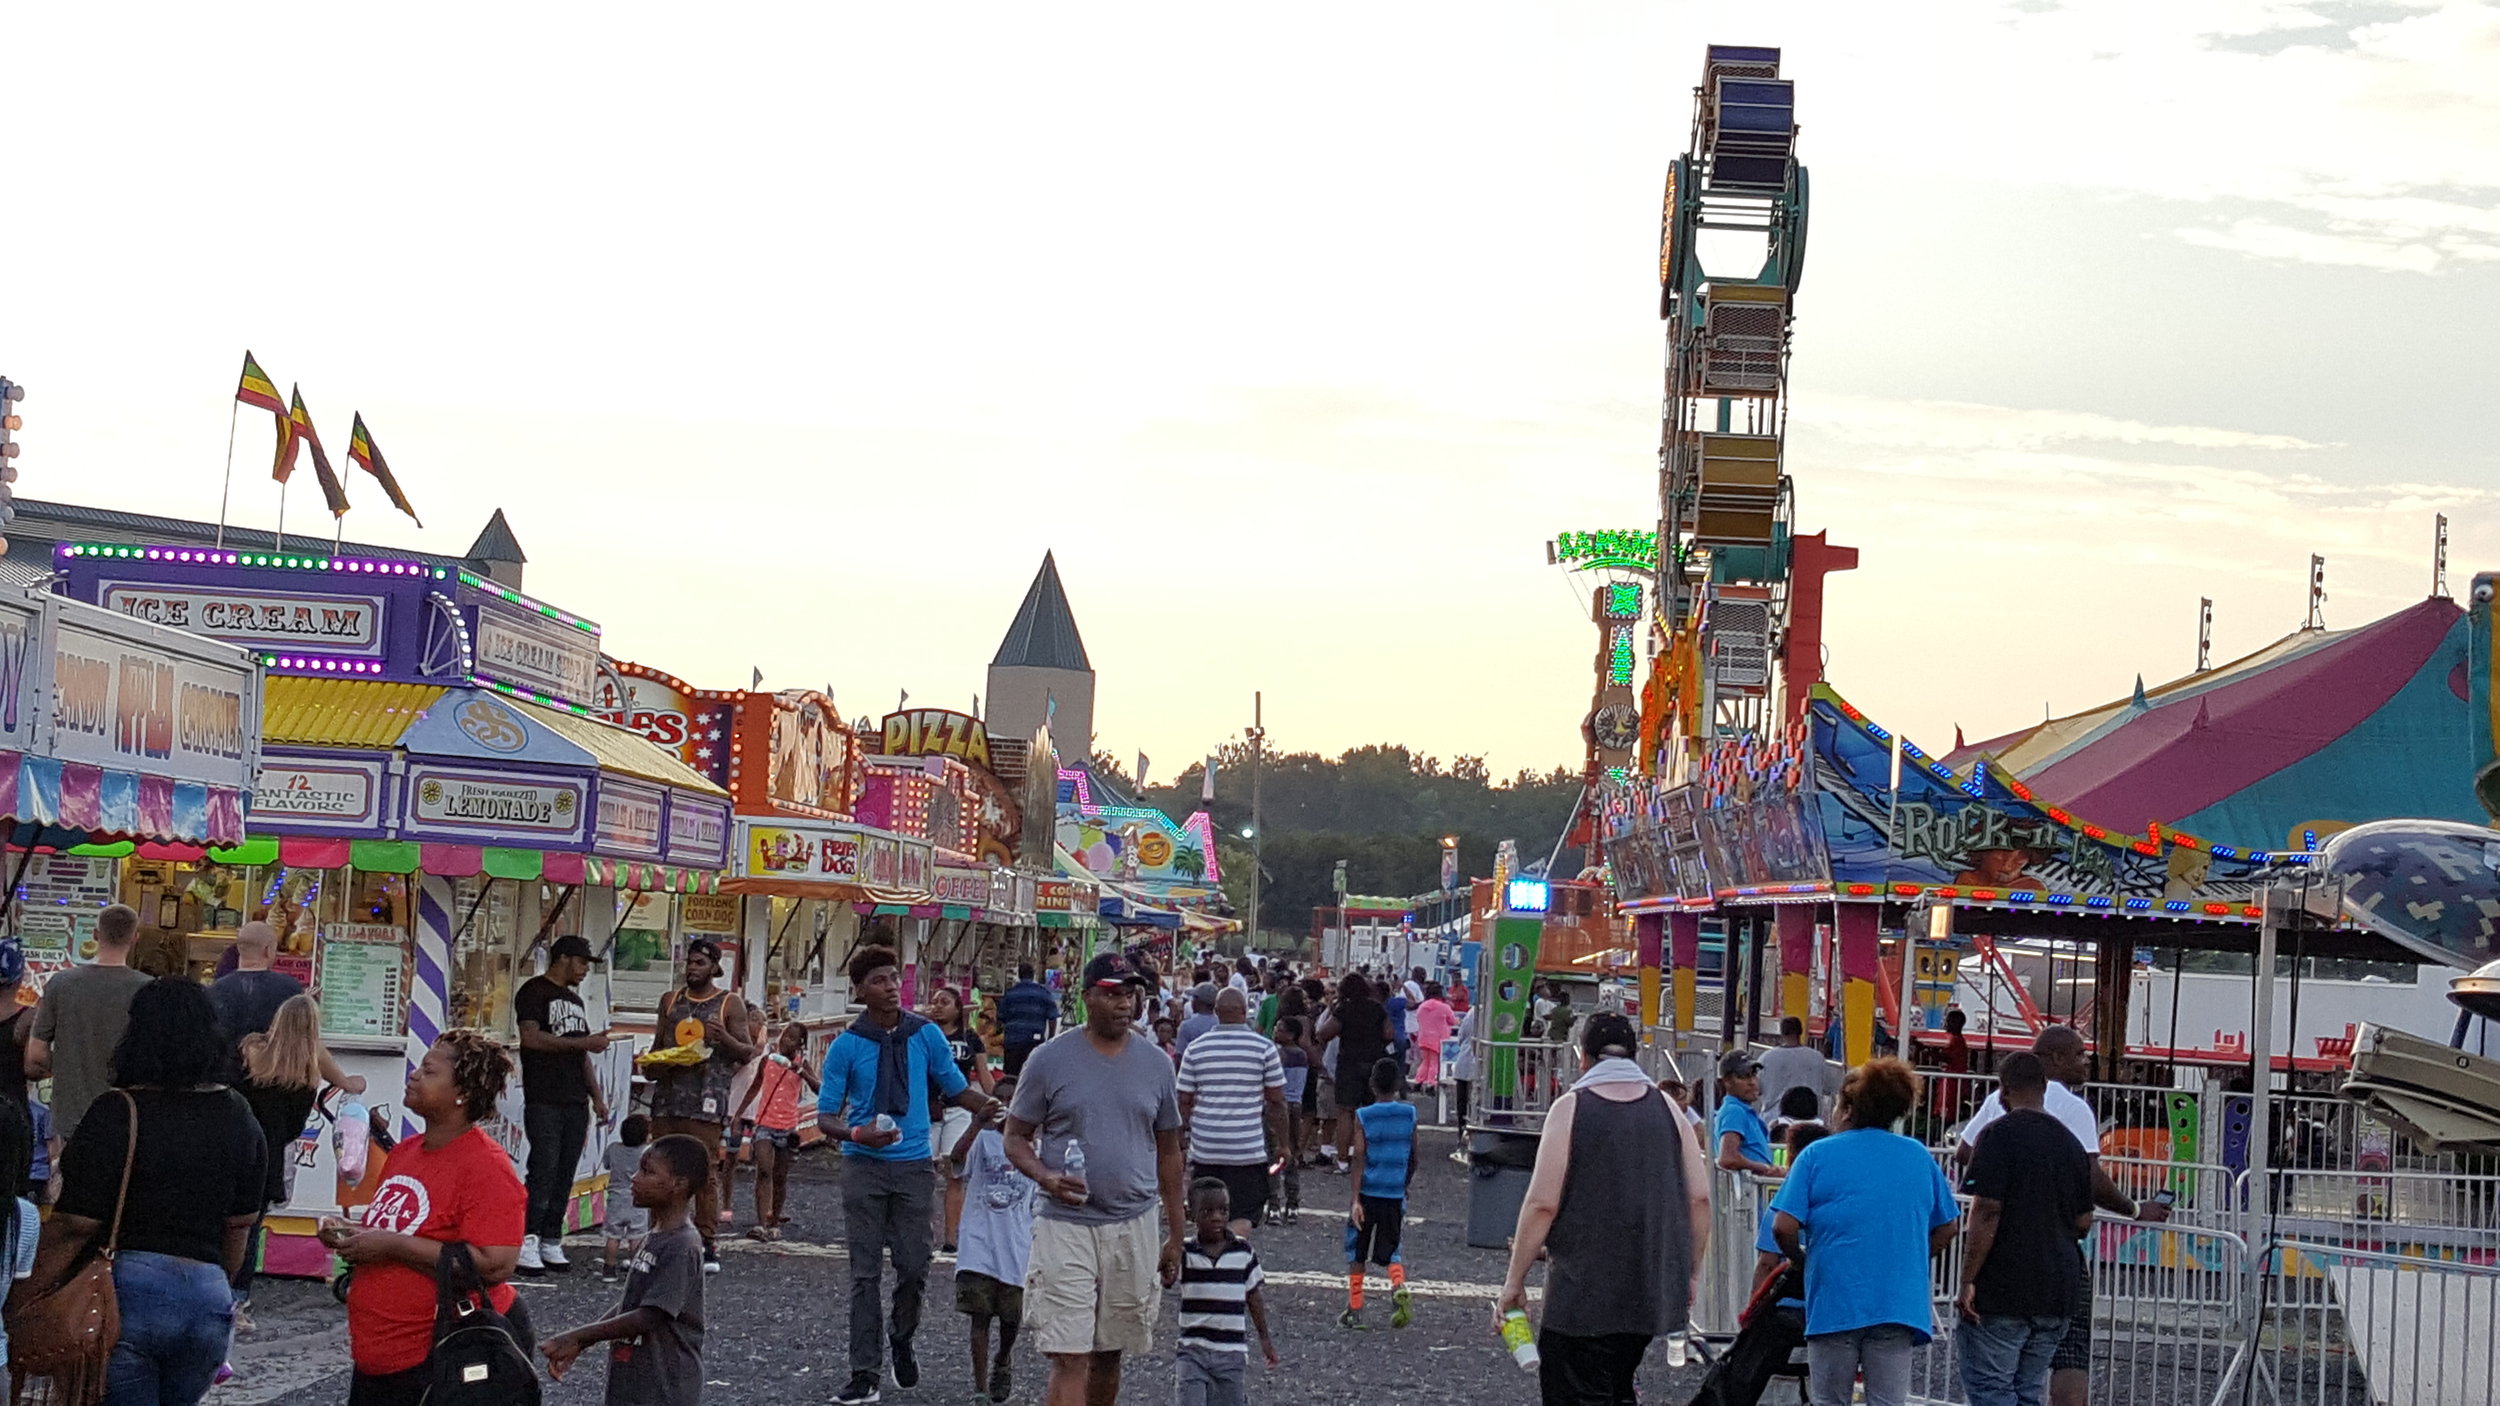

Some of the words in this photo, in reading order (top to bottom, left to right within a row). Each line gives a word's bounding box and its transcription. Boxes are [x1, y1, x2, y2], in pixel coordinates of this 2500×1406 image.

[120, 596, 189, 625] ICE
[201, 601, 361, 636] CREAM
[55, 651, 110, 736] CANDY
[884, 711, 992, 770] PIZZA
[287, 774, 312, 790] 12
[461, 784, 489, 796] FRESH
[254, 789, 355, 802] ANTASTIC
[253, 798, 345, 812] FLAVORS
[444, 794, 552, 823] LEMONADE
[821, 838, 858, 857] FRIES
[821, 856, 856, 875] DOGS
[685, 908, 712, 921] CORN
[713, 910, 735, 924] DOG
[22, 950, 40, 959] ASH
[42, 951, 63, 960] ONLY
